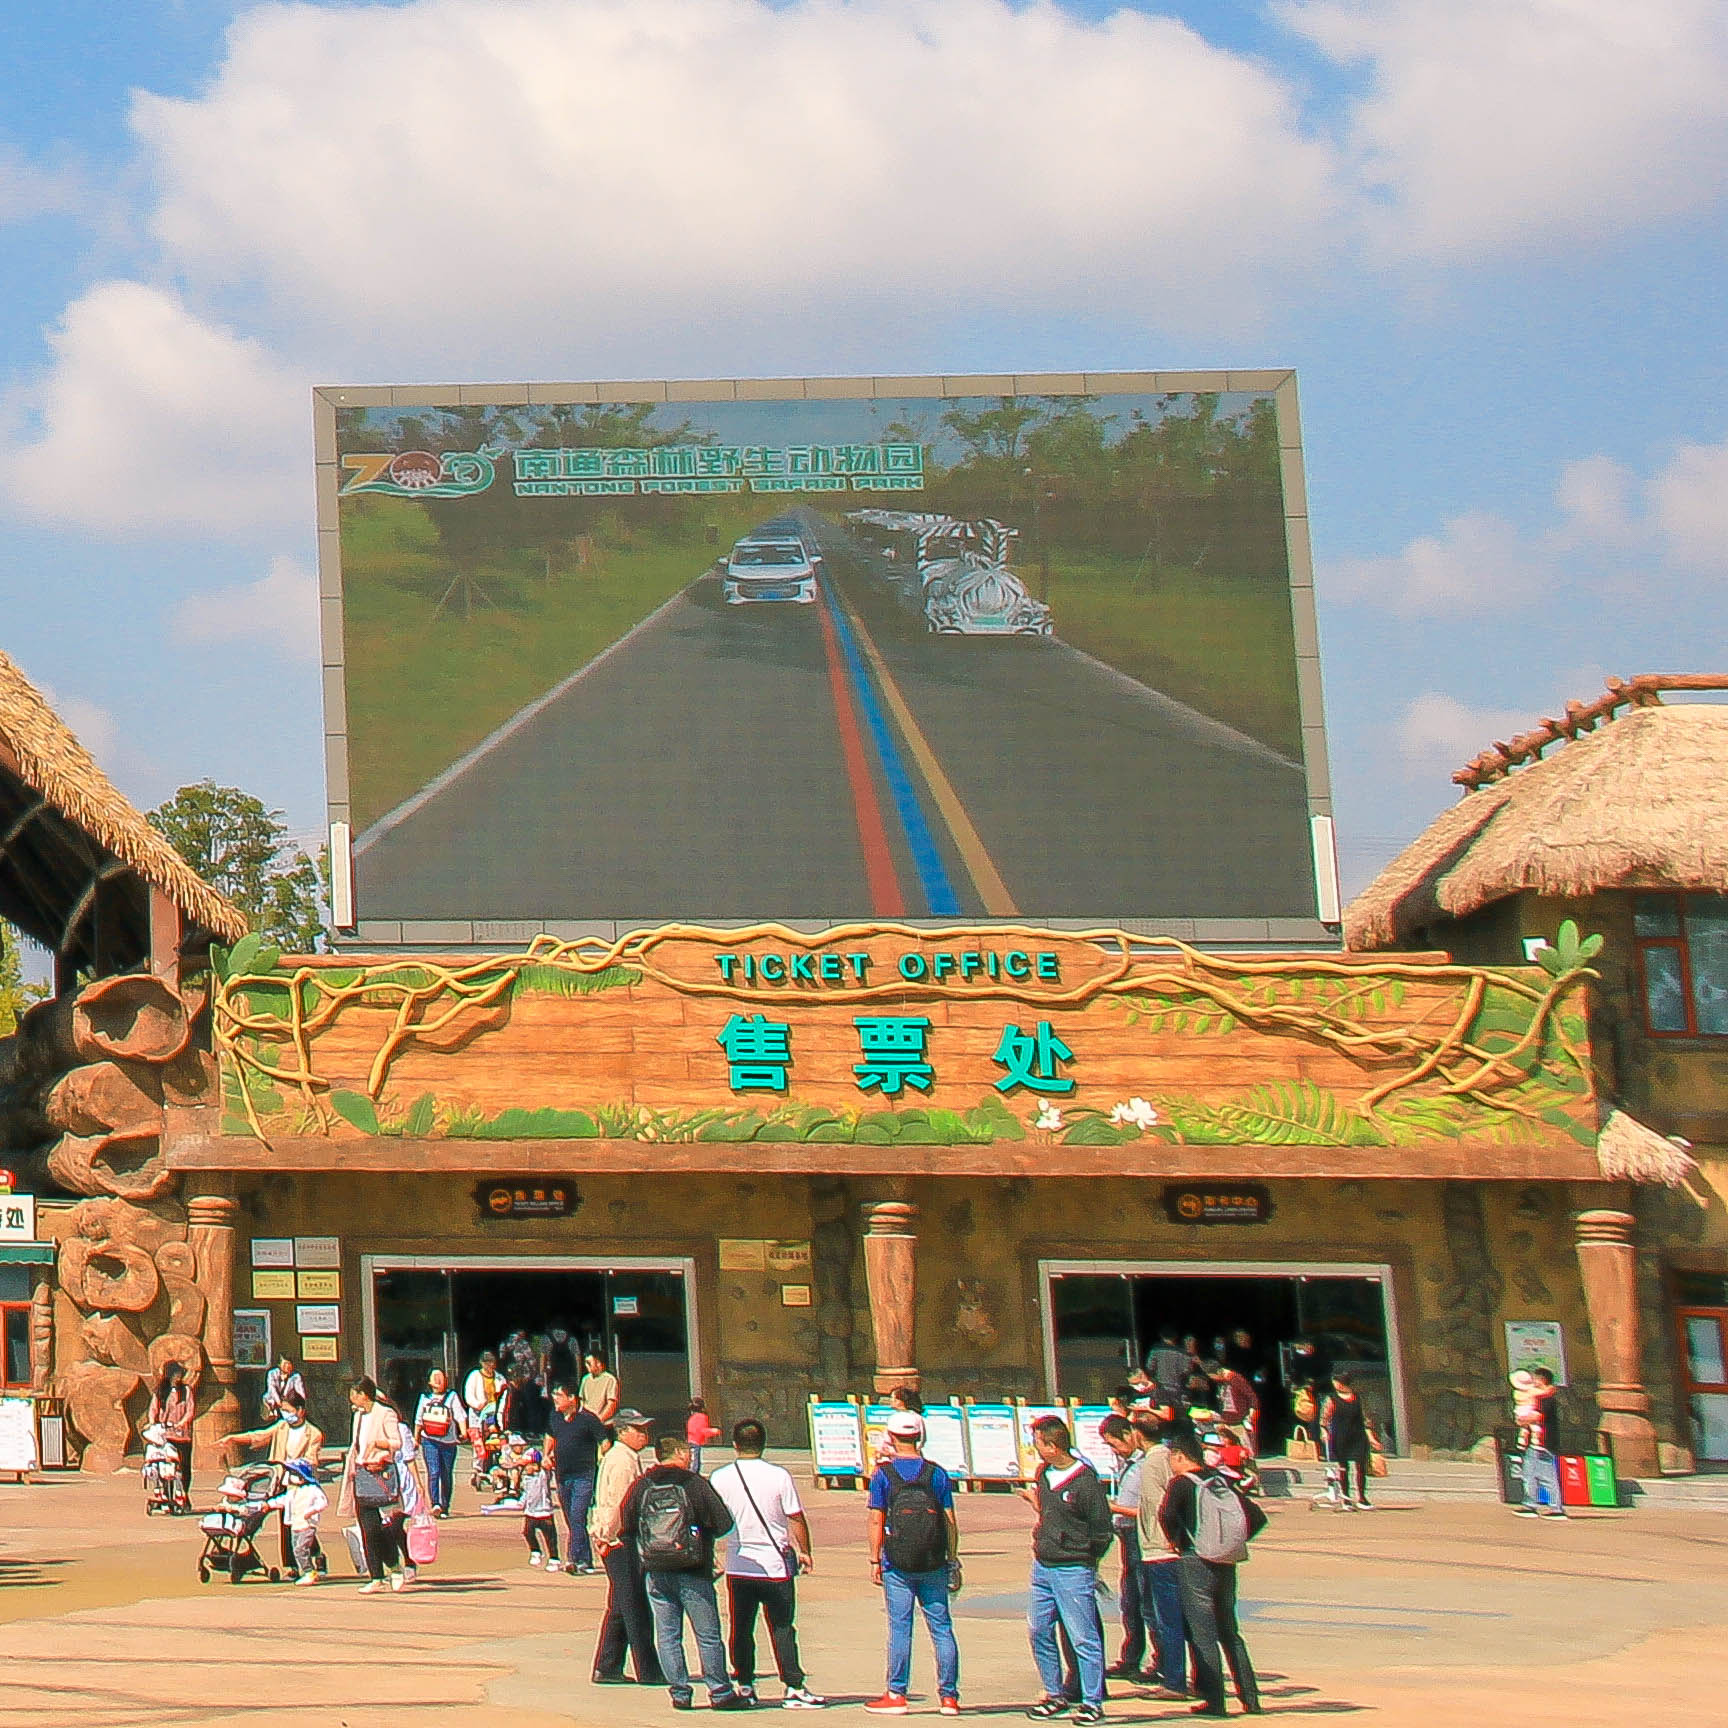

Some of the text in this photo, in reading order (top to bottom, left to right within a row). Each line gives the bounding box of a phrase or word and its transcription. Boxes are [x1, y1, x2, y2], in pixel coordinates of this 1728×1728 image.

[514, 443, 924, 479] 南通森林野生动物园
[514, 480, 636, 497] NANTONG
[641, 478, 744, 494] FOREST
[852, 475, 924, 492] PARK
[713, 951, 1058, 981] TICKET OFFICE
[716, 1013, 1076, 1094] 售票处
